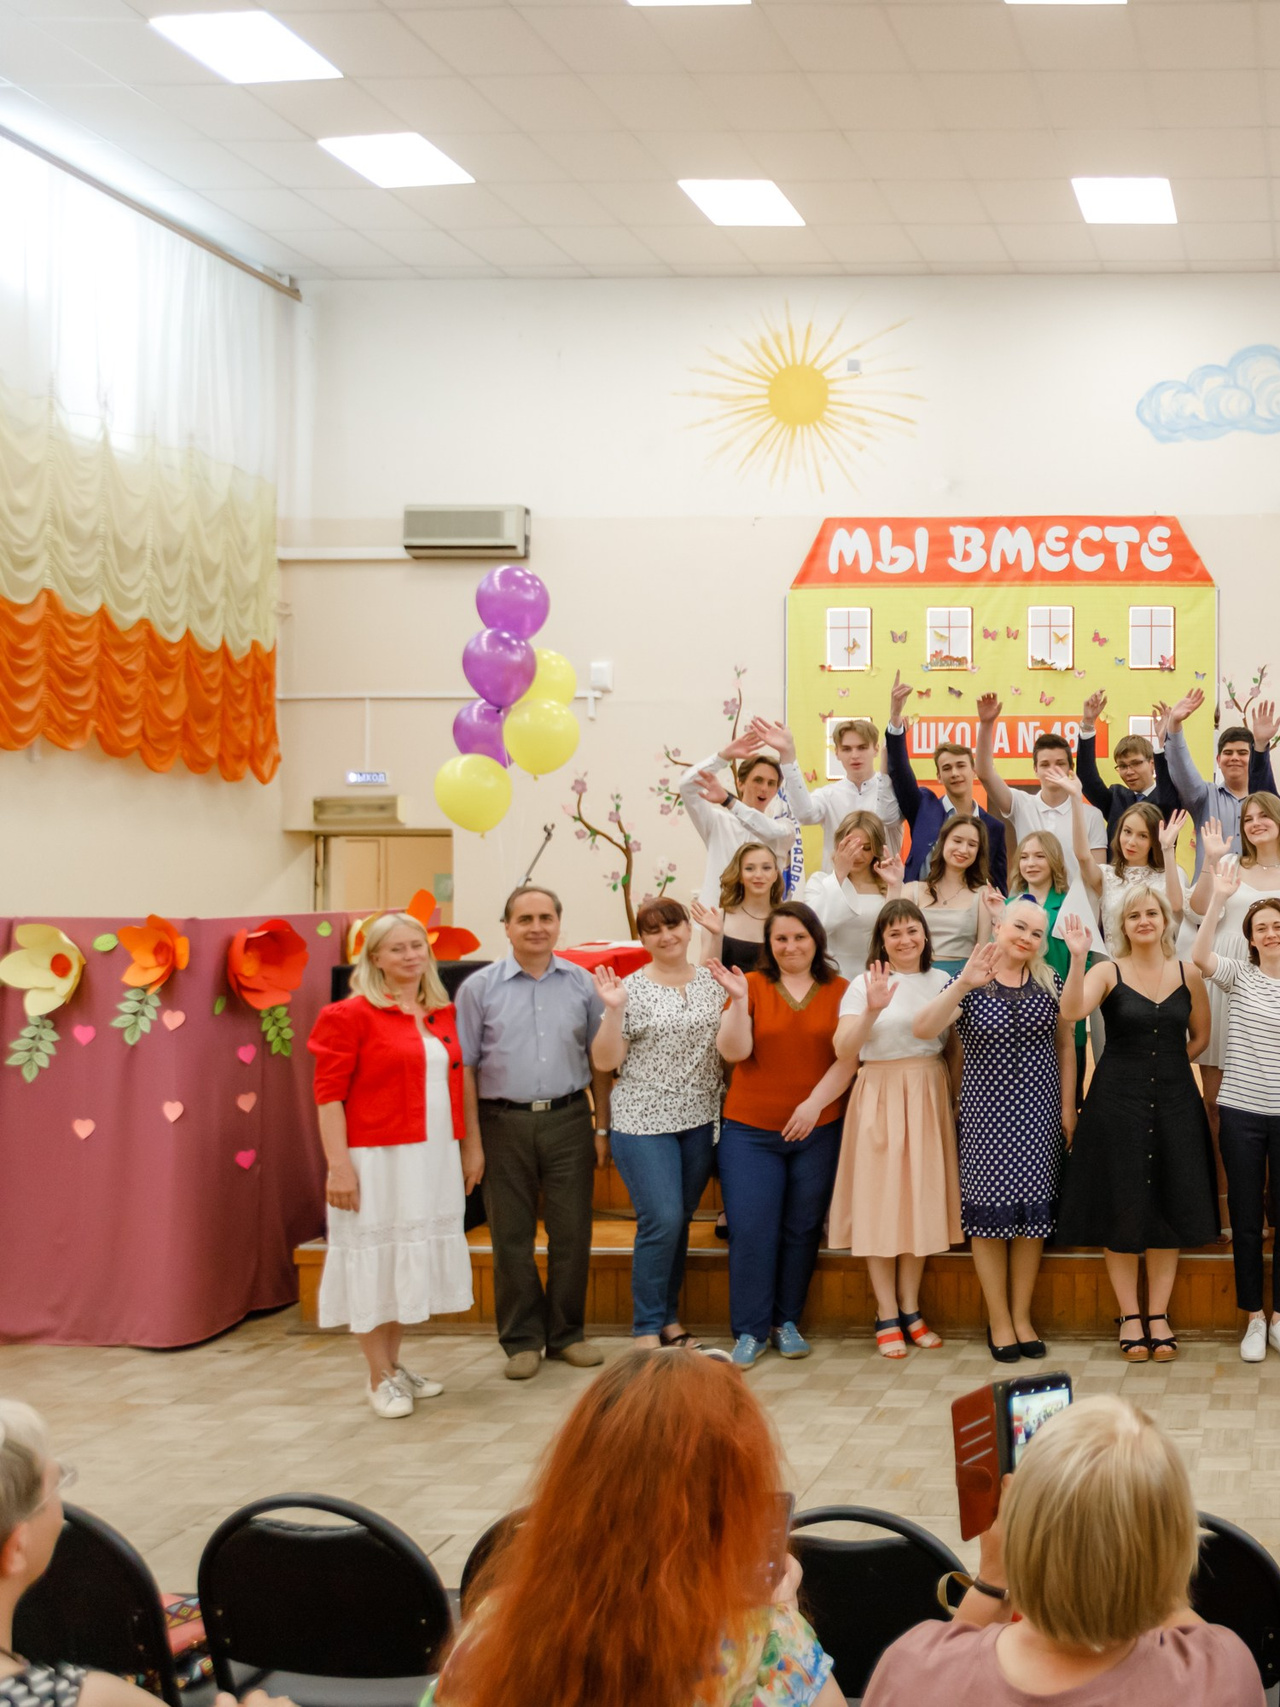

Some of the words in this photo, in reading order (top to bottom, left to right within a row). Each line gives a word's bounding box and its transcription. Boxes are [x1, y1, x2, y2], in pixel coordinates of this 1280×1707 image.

[828, 525, 930, 575] МЫ
[947, 525, 1173, 574] ВМЕСТЕ
[912, 721, 1011, 754] ШКОА
